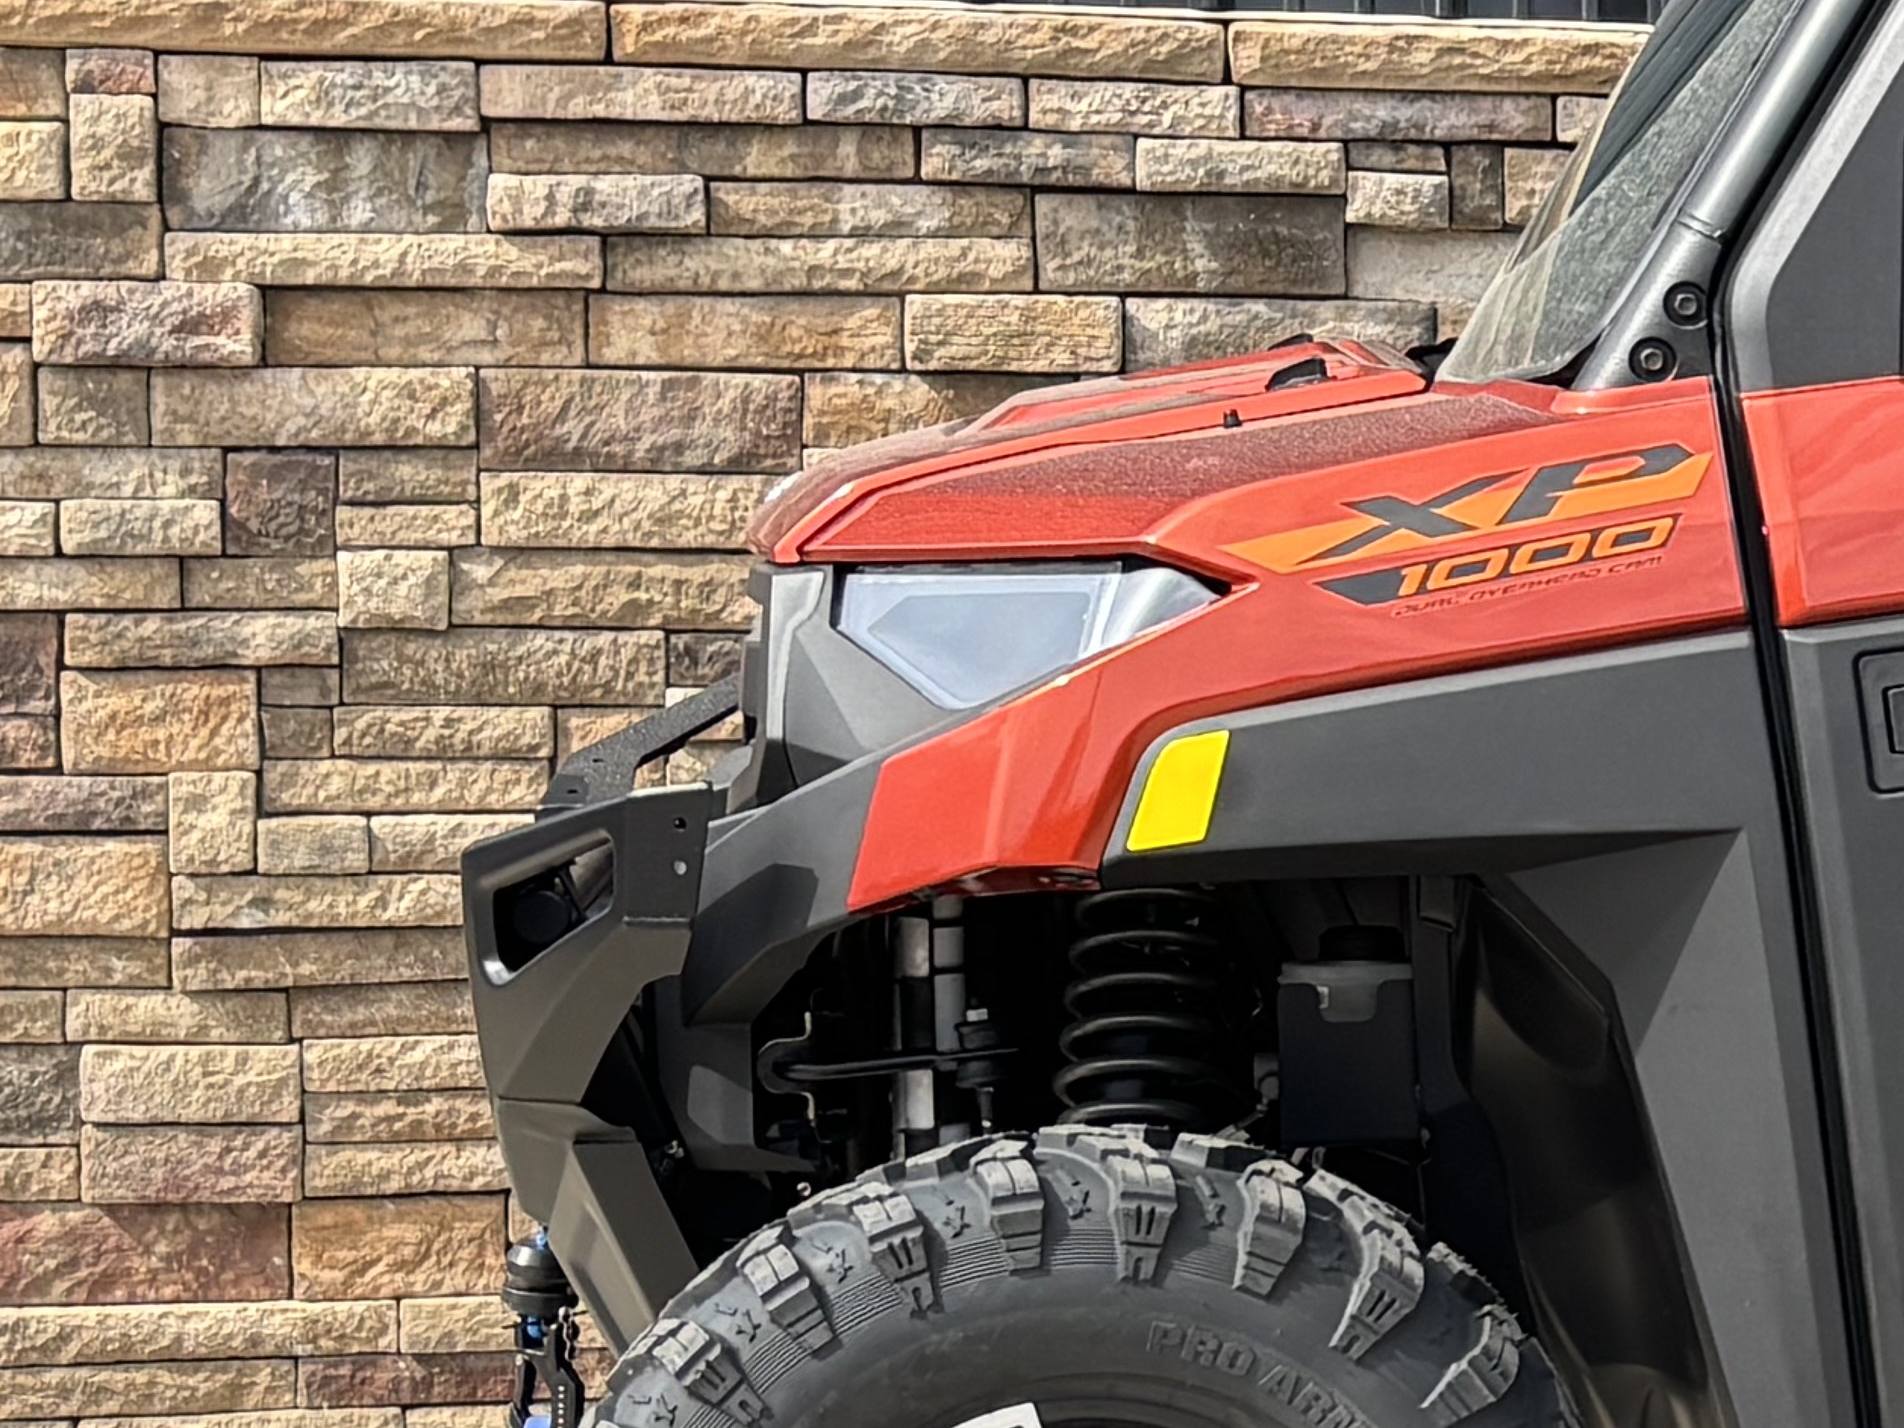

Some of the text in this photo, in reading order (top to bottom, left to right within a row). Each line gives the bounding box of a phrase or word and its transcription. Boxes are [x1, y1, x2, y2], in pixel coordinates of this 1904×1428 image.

[1295, 443, 1695, 564] XP
[1398, 517, 1673, 596] 1000
[1469, 568, 1602, 602] OVERHEAD
[1608, 555, 1663, 574] CAM
[1146, 1320, 1257, 1375] PRO
